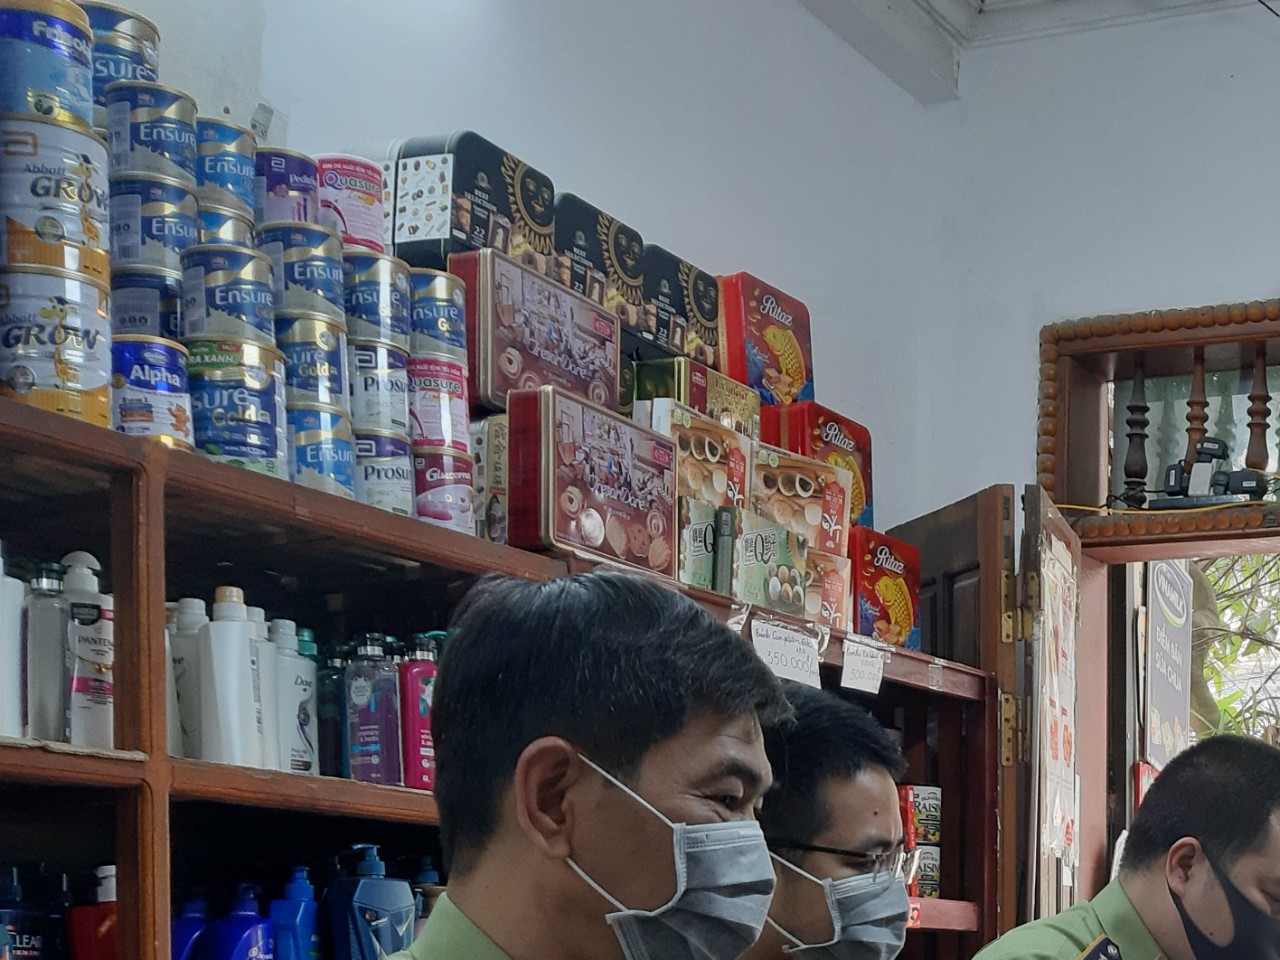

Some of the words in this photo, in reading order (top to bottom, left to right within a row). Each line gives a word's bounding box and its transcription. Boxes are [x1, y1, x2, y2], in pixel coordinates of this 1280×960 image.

[130, 365, 182, 388] Alpha
[823, 421, 855, 452] Ritaz
[873, 545, 906, 575] Ritaz
[294, 675, 313, 688] Dove
